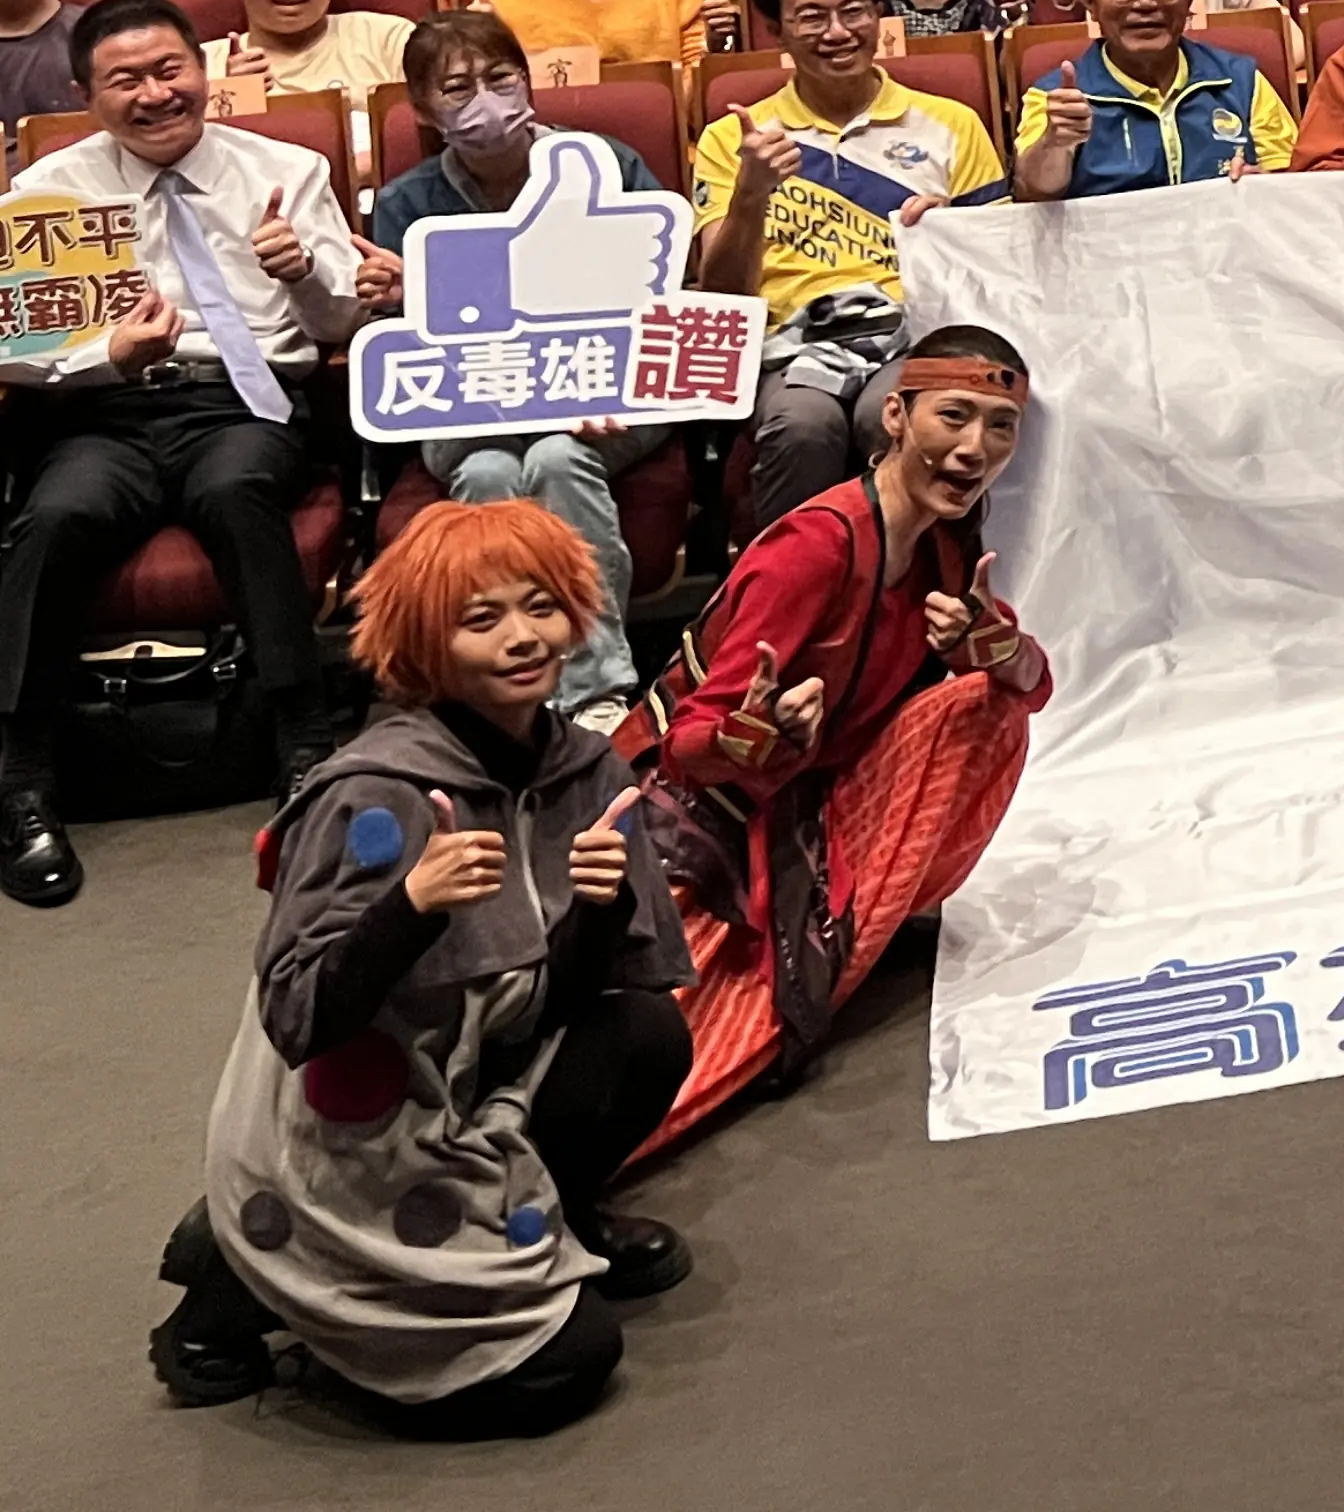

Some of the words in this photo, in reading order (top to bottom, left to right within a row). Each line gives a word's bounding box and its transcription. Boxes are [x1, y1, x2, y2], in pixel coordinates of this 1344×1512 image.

[776, 184, 897, 250] AOHSIUN
[375, 304, 748, 416] 反毒雄讚
